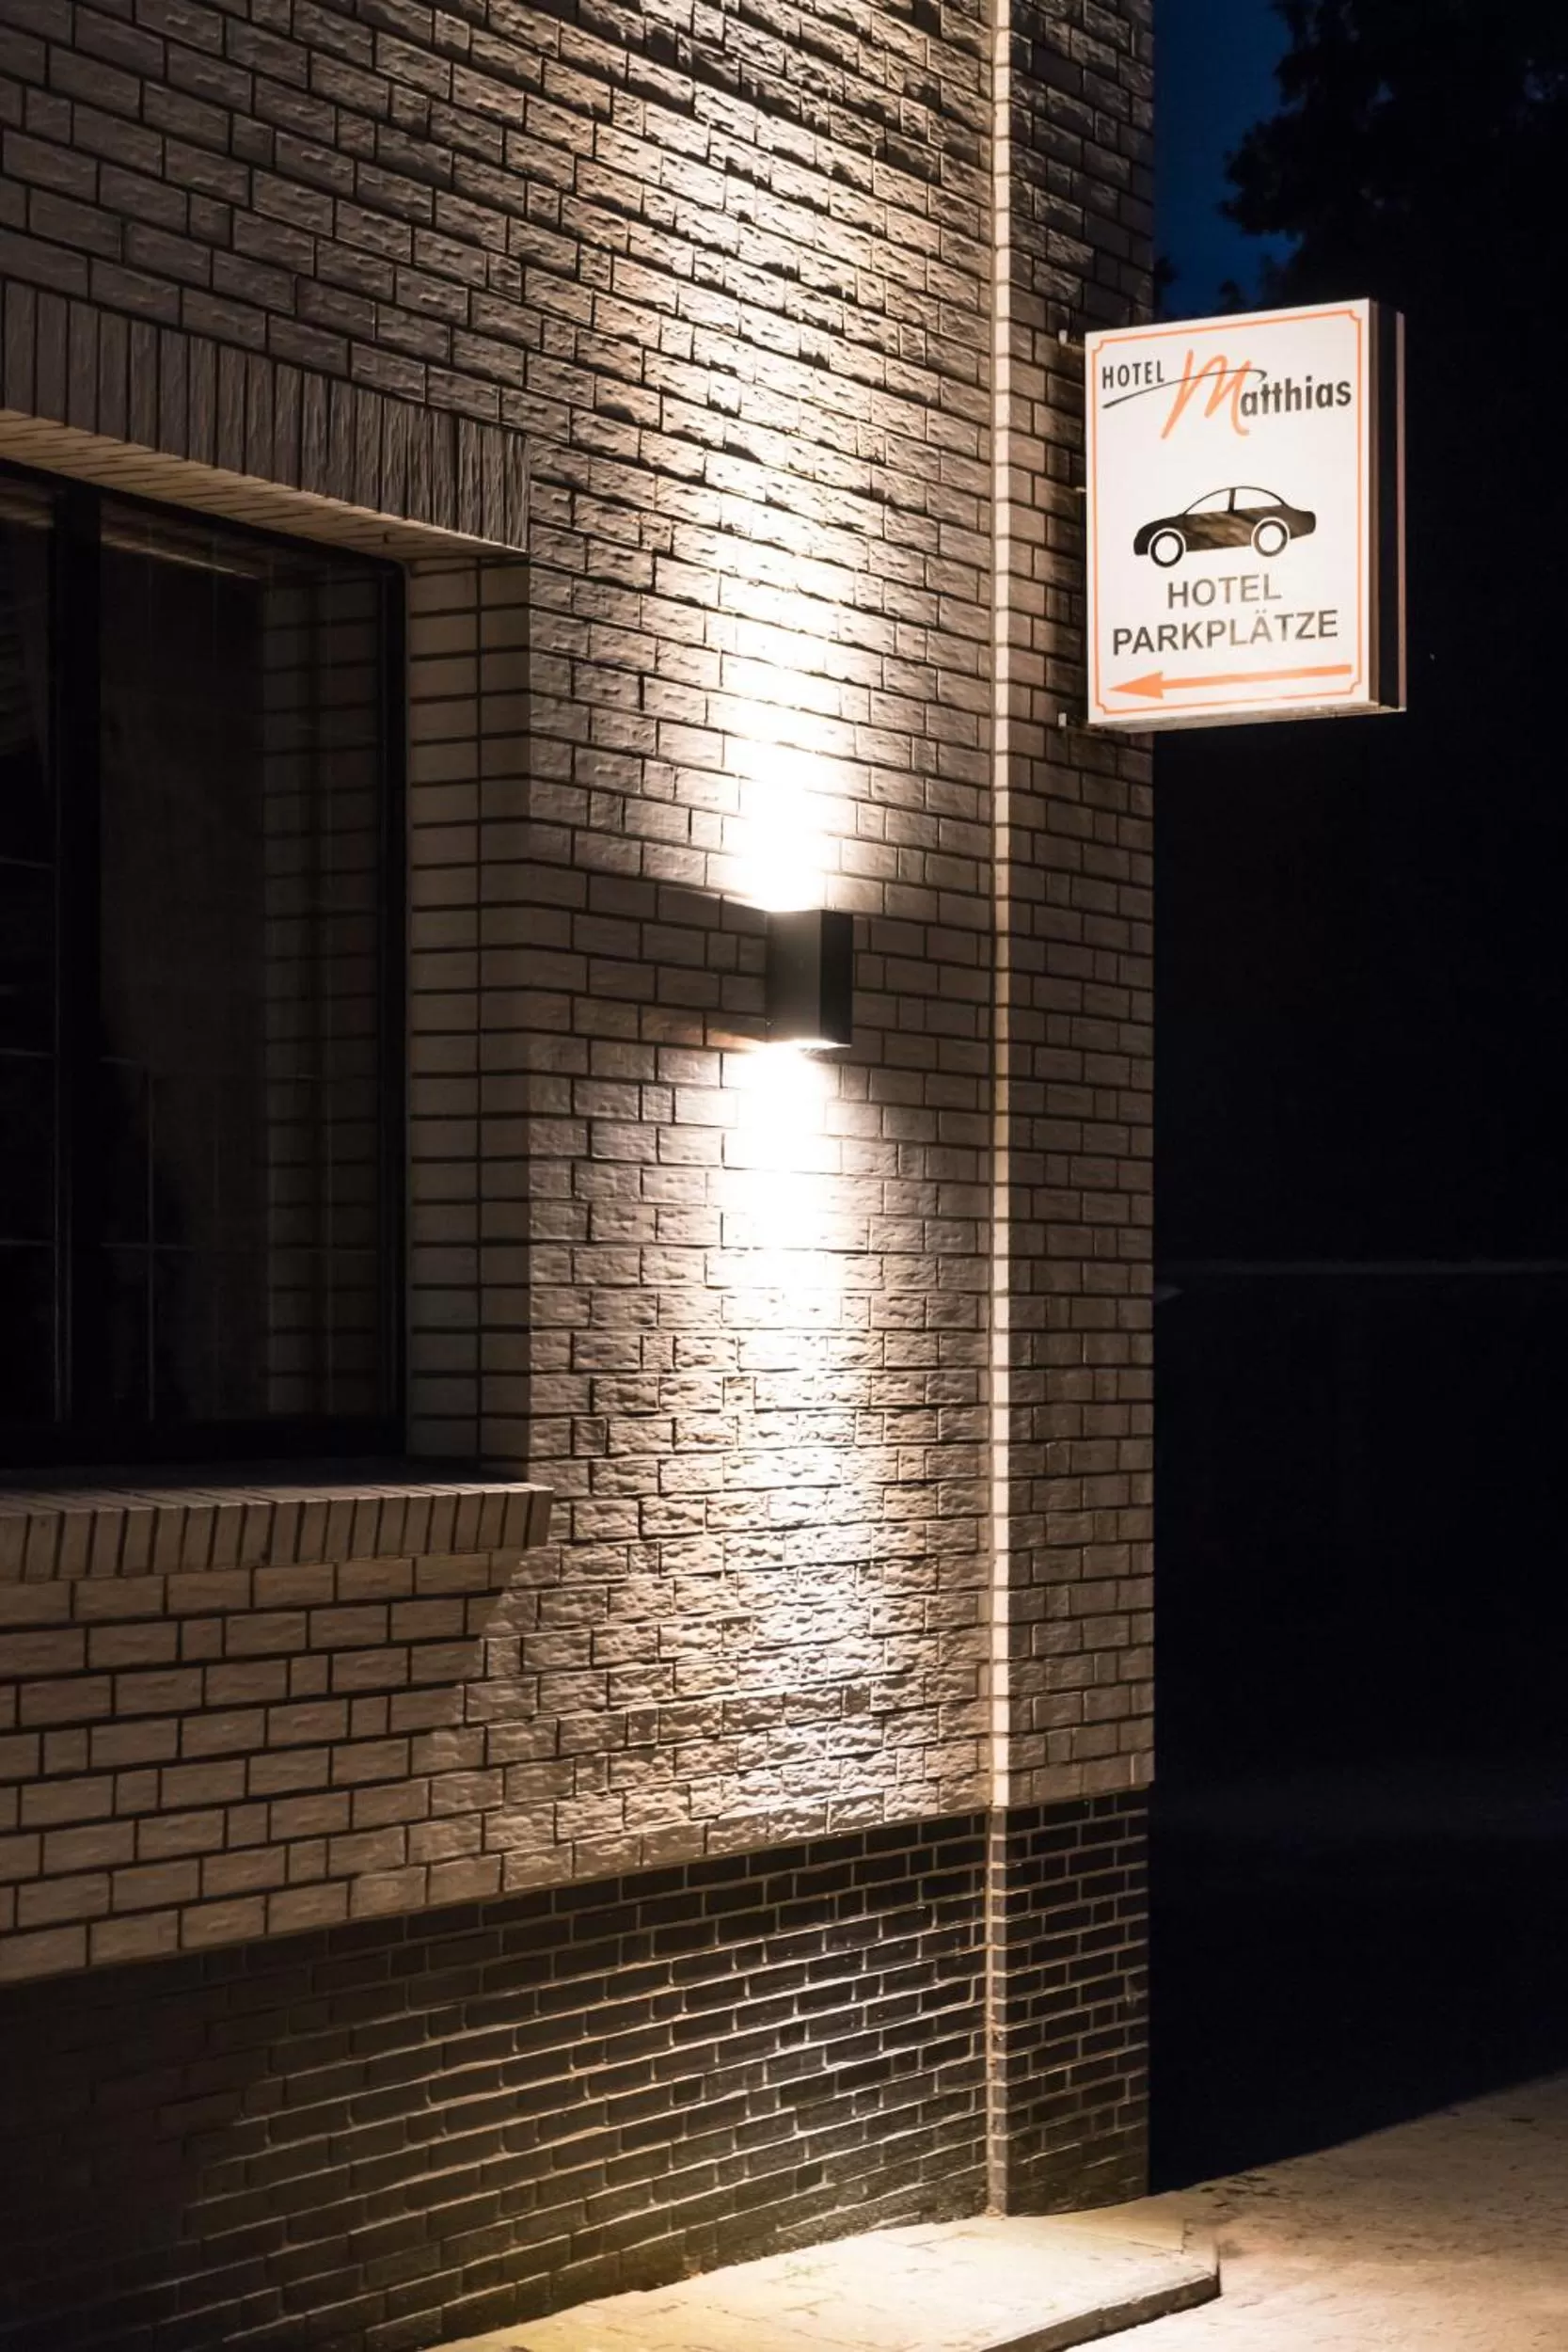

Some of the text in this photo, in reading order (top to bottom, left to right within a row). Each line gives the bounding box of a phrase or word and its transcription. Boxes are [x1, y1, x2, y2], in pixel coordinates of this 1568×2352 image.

[1101, 349, 1353, 437] HOTEL Matthias
[1167, 573, 1282, 610] HOTEL
[1113, 609, 1338, 656] PARKPLÄTZE
